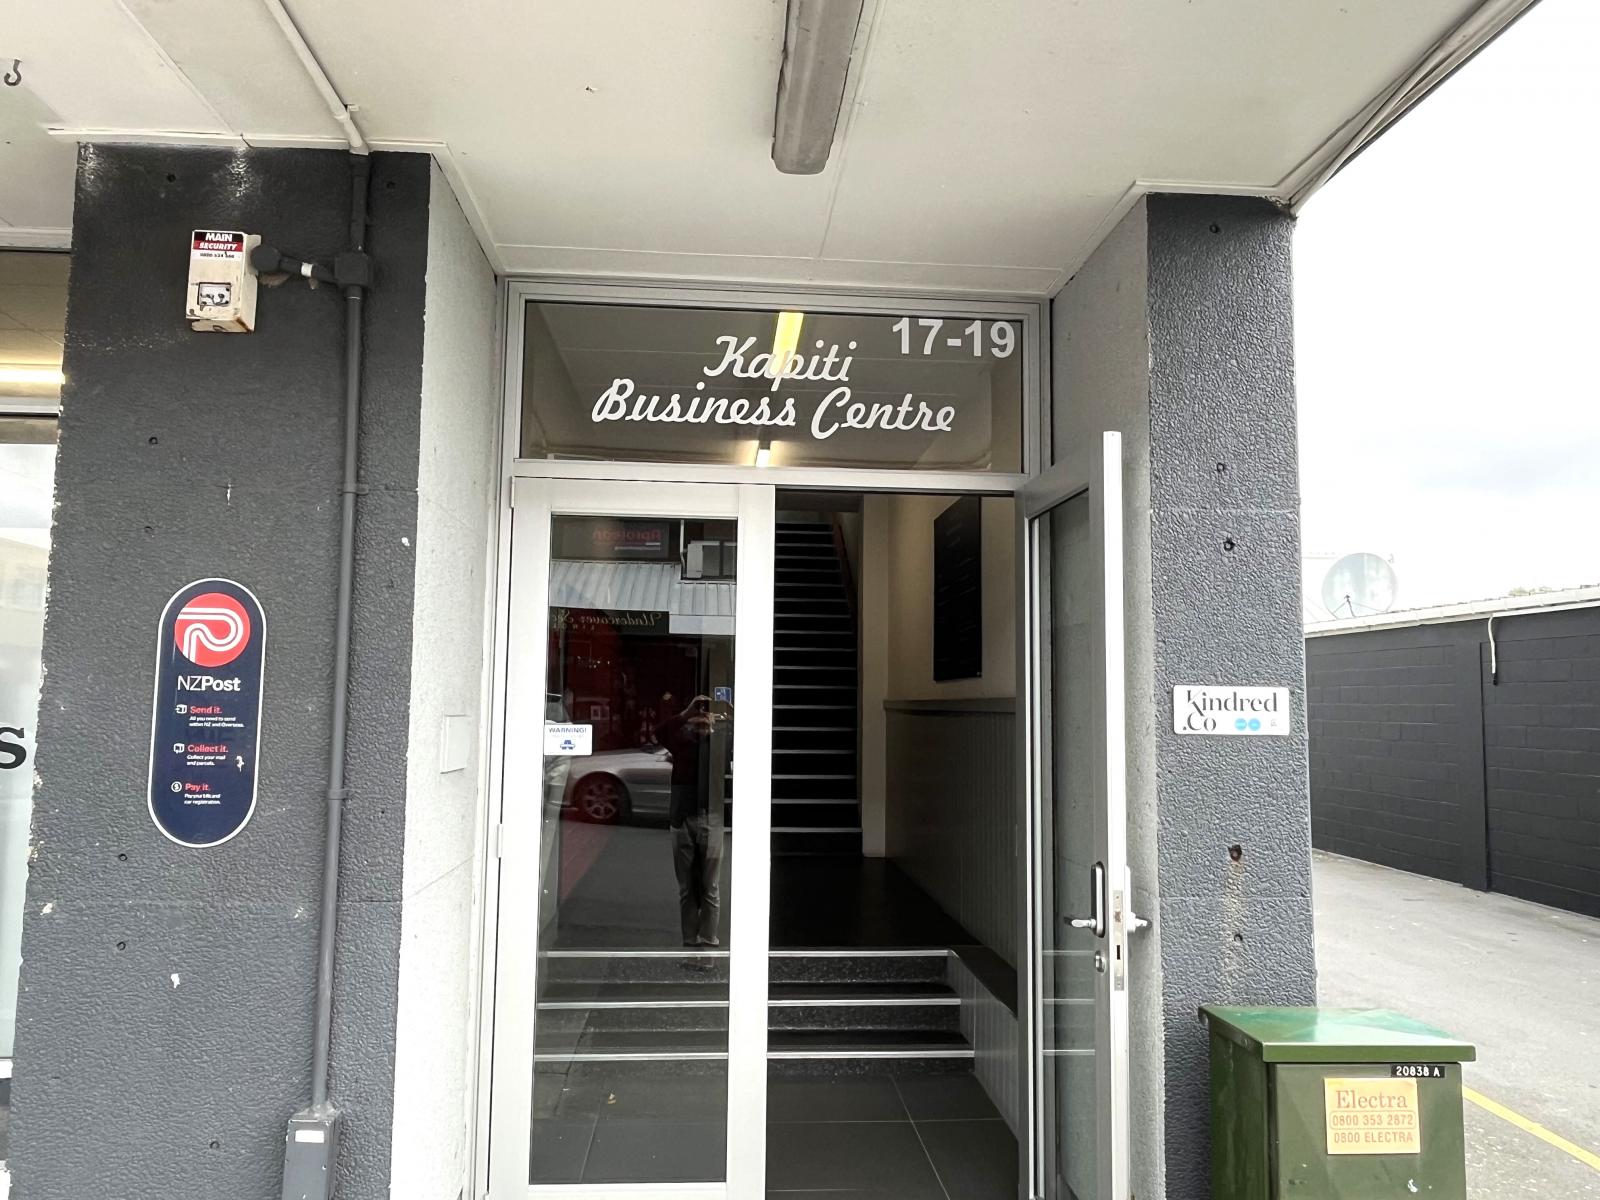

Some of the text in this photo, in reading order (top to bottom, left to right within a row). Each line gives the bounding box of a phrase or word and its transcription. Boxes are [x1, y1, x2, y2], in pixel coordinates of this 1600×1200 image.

[205, 232, 233, 242] MAIN
[199, 242, 238, 250] SECURITY
[891, 316, 1016, 359] 17-19
[703, 335, 857, 391] Kapiti
[591, 378, 956, 439] Business Centre
[177, 675, 242, 692] NZPost
[1186, 689, 1278, 717] Kindred
[190, 705, 212, 714] Send
[187, 744, 219, 753] Collect
[185, 783, 201, 793] Pay
[1396, 1065, 1441, 1077] 20838 A
[1335, 1089, 1409, 1109] Electra
[1332, 1114, 1414, 1126] 0800 353 2872
[1334, 1131, 1414, 1144] 0800 ELECTRA
